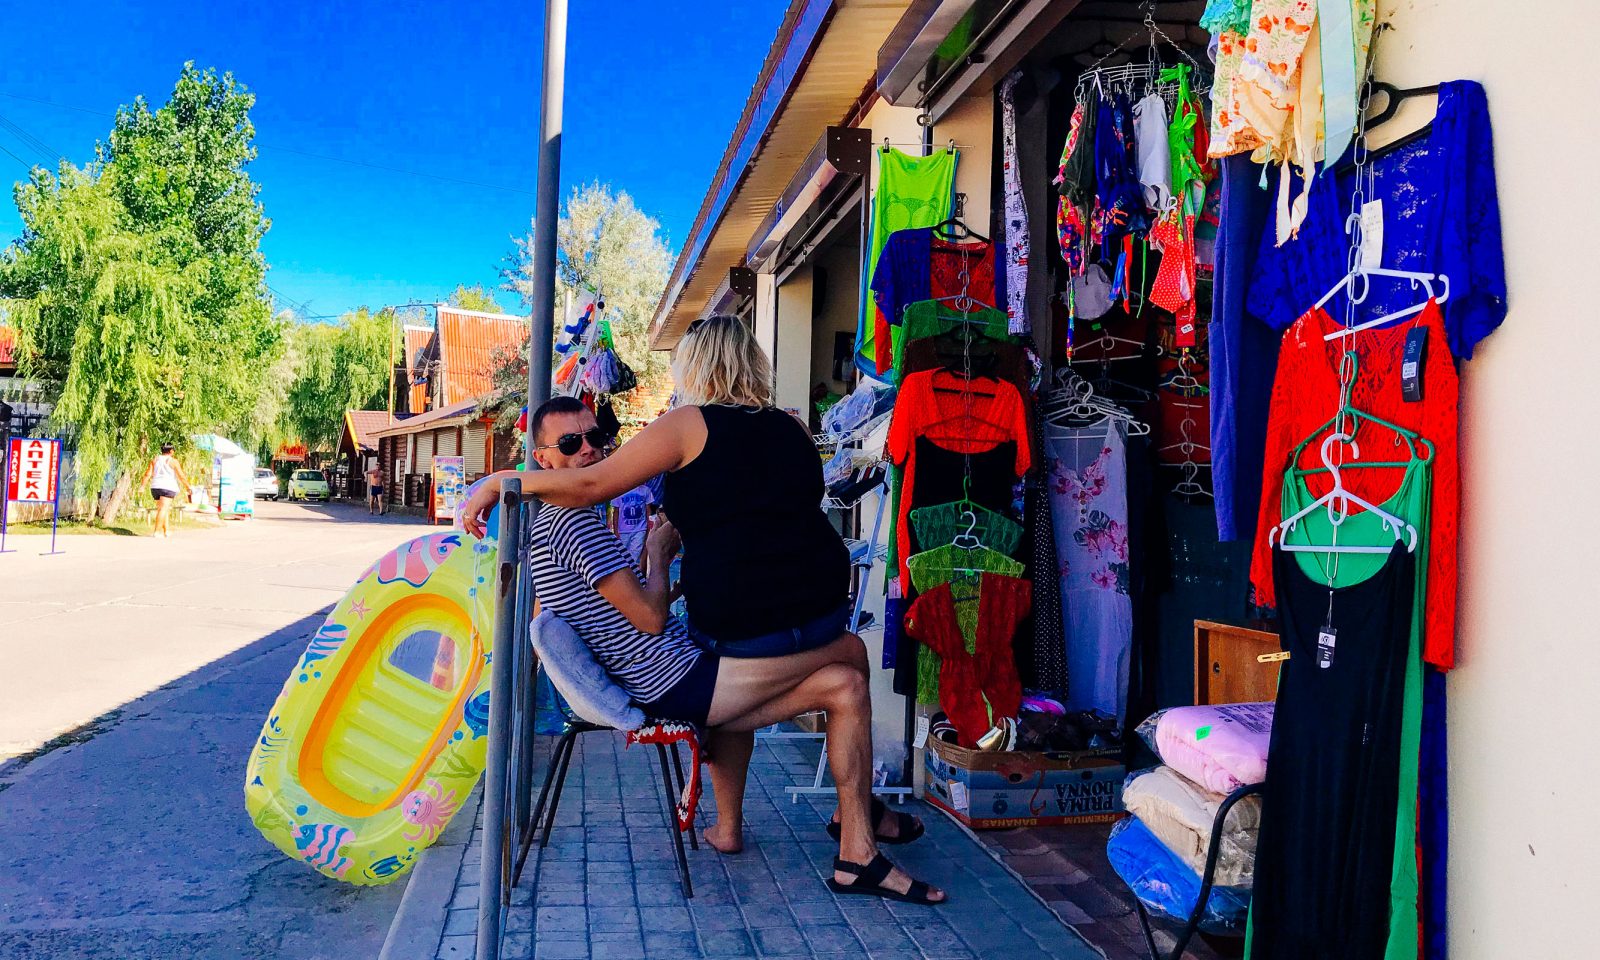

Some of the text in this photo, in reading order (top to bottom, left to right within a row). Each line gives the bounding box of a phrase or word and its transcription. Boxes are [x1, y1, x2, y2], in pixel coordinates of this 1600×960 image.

[11, 450, 19, 483] ЗАКАЗ
[25, 440, 43, 499] АПТЕКА
[1054, 780, 1115, 799] DONNA
[1055, 796, 1114, 814] PRIMA
[982, 814, 1116, 827] PREMIUM BANANAS
